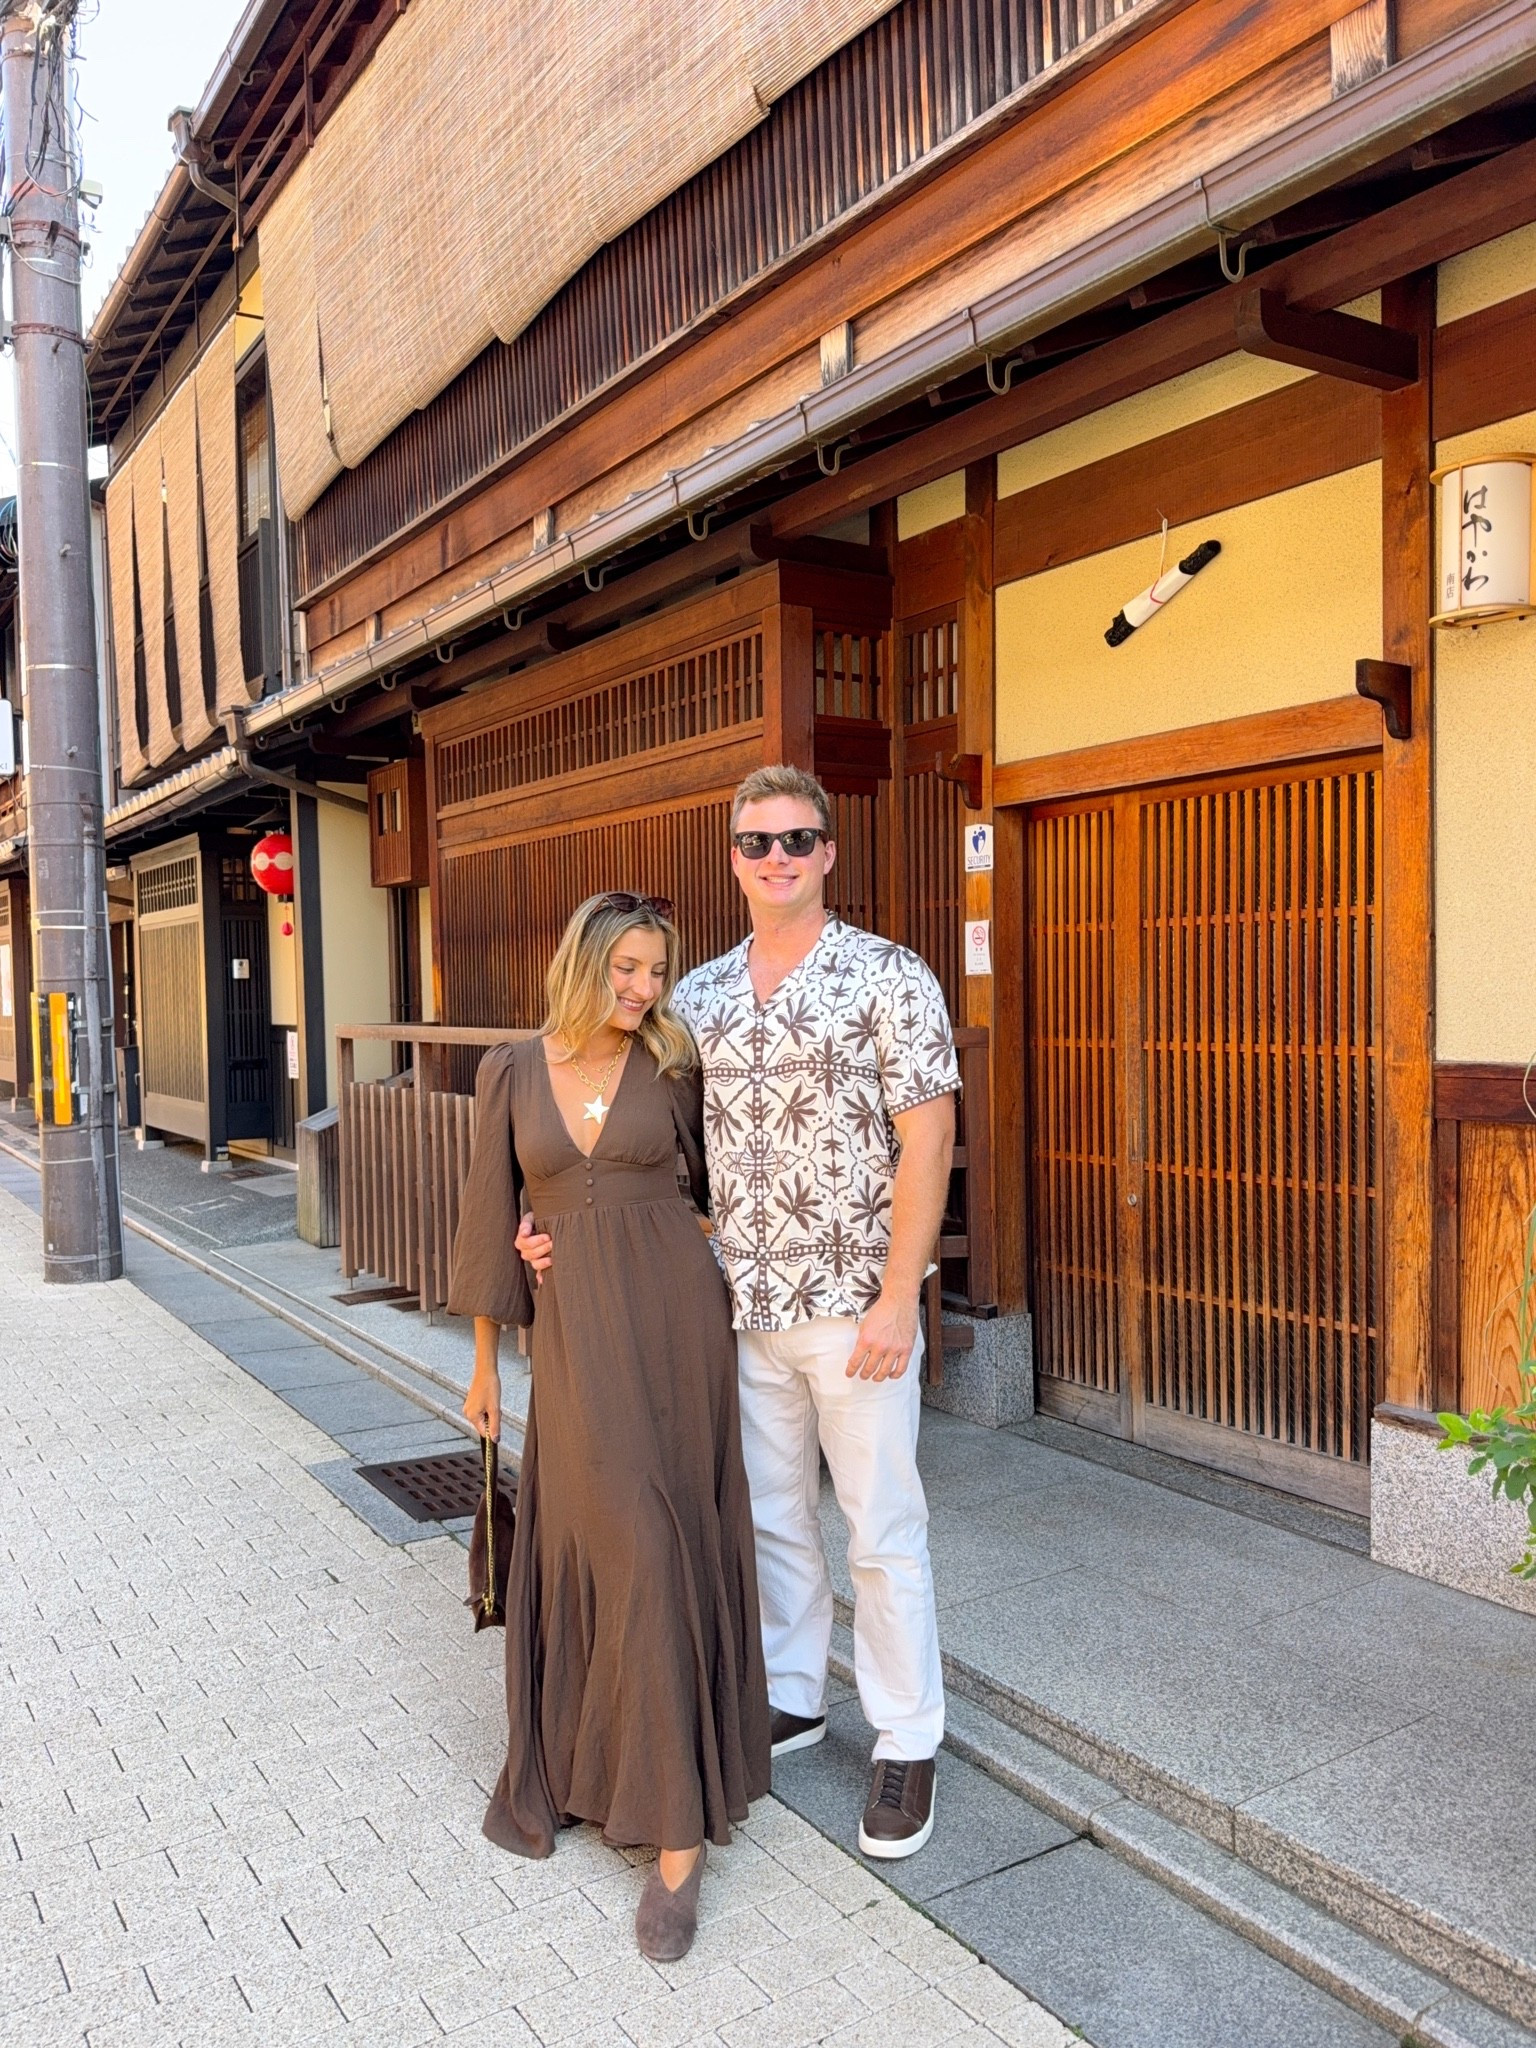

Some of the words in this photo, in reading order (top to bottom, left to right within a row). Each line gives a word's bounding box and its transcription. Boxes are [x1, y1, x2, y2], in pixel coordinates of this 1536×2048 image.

[1462, 485, 1492, 592] はやかわ
[1446, 572, 1455, 599] 南店
[967, 854, 991, 865] SECURITY
